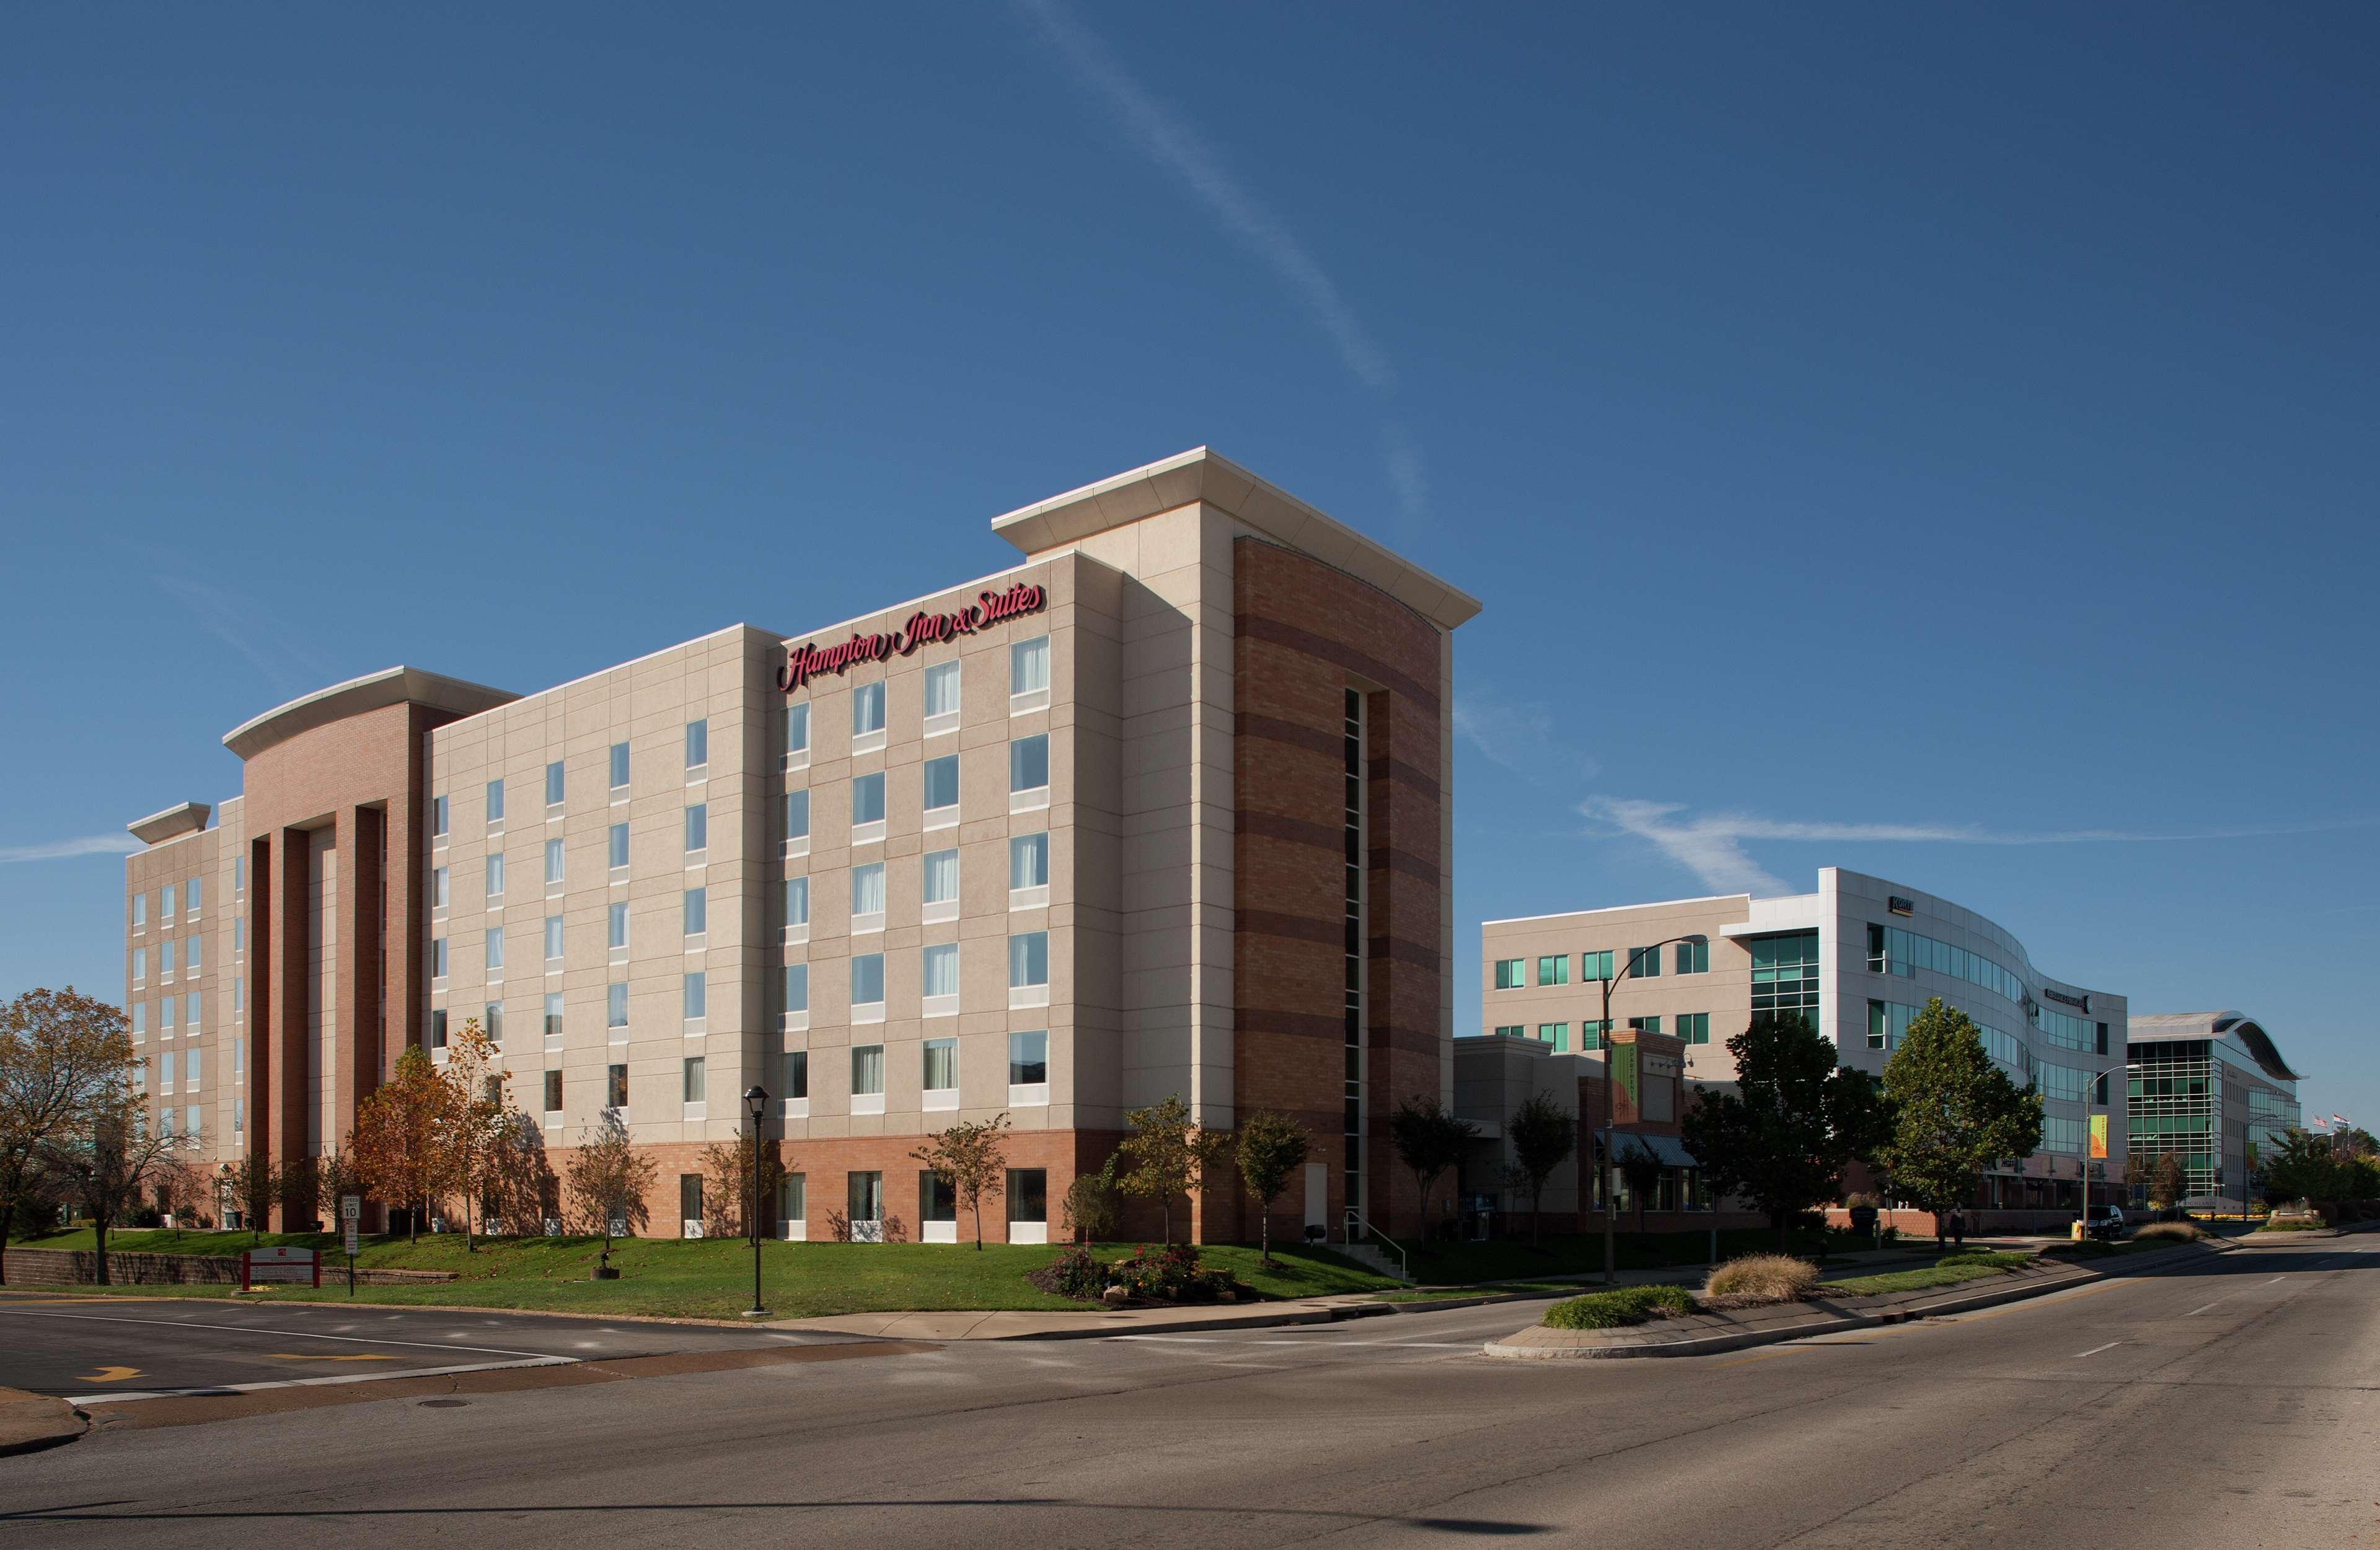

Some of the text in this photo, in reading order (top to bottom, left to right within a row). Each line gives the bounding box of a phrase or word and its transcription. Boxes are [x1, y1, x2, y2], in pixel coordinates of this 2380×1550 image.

[777, 582, 1041, 691] Hampton Inn & Suites
[1893, 897, 1914, 911] KORTE
[345, 1208, 356, 1217] 10
